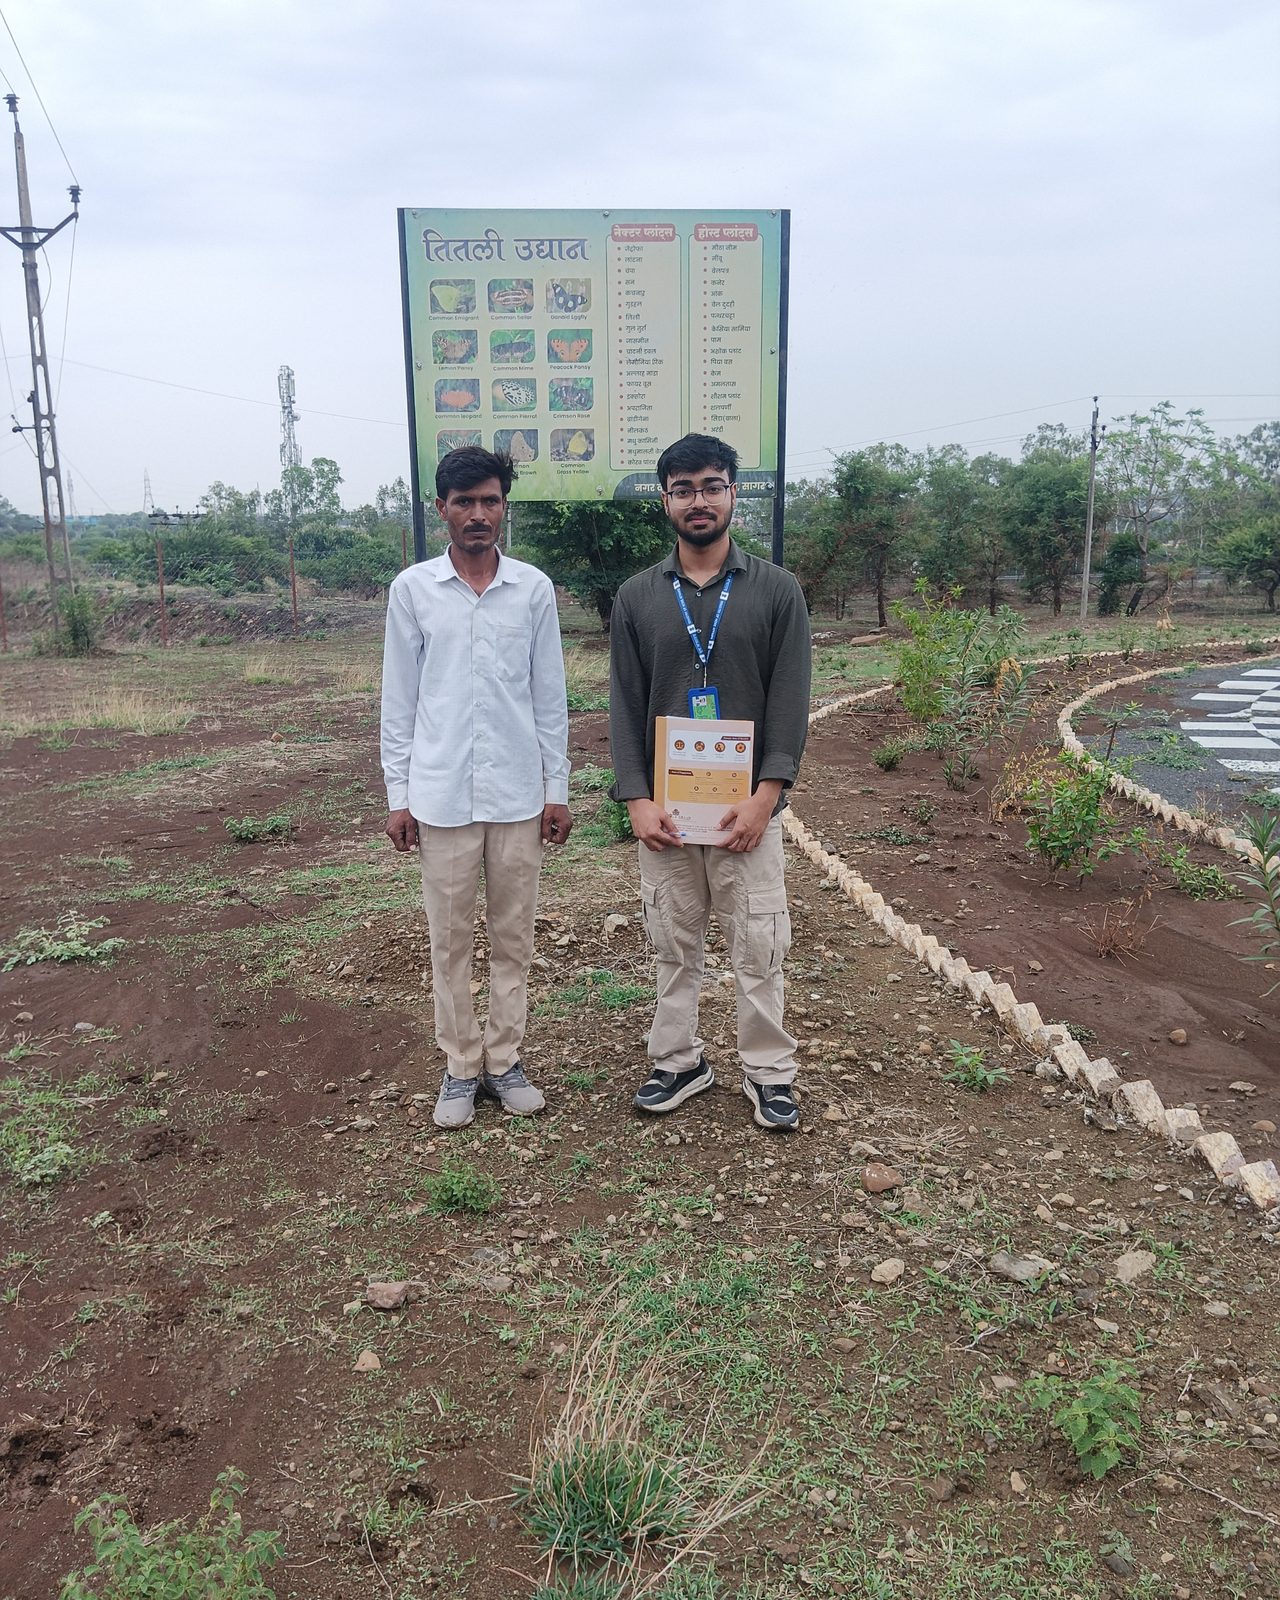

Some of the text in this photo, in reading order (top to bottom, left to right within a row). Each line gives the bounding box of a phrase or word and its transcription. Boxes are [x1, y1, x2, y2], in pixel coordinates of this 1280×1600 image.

[613, 225, 642, 238] नेक्टर
[698, 225, 721, 240] होस्ट
[422, 228, 590, 262] तितली उद्यान
[634, 483, 656, 492] नगर
[741, 481, 766, 491] सागर
